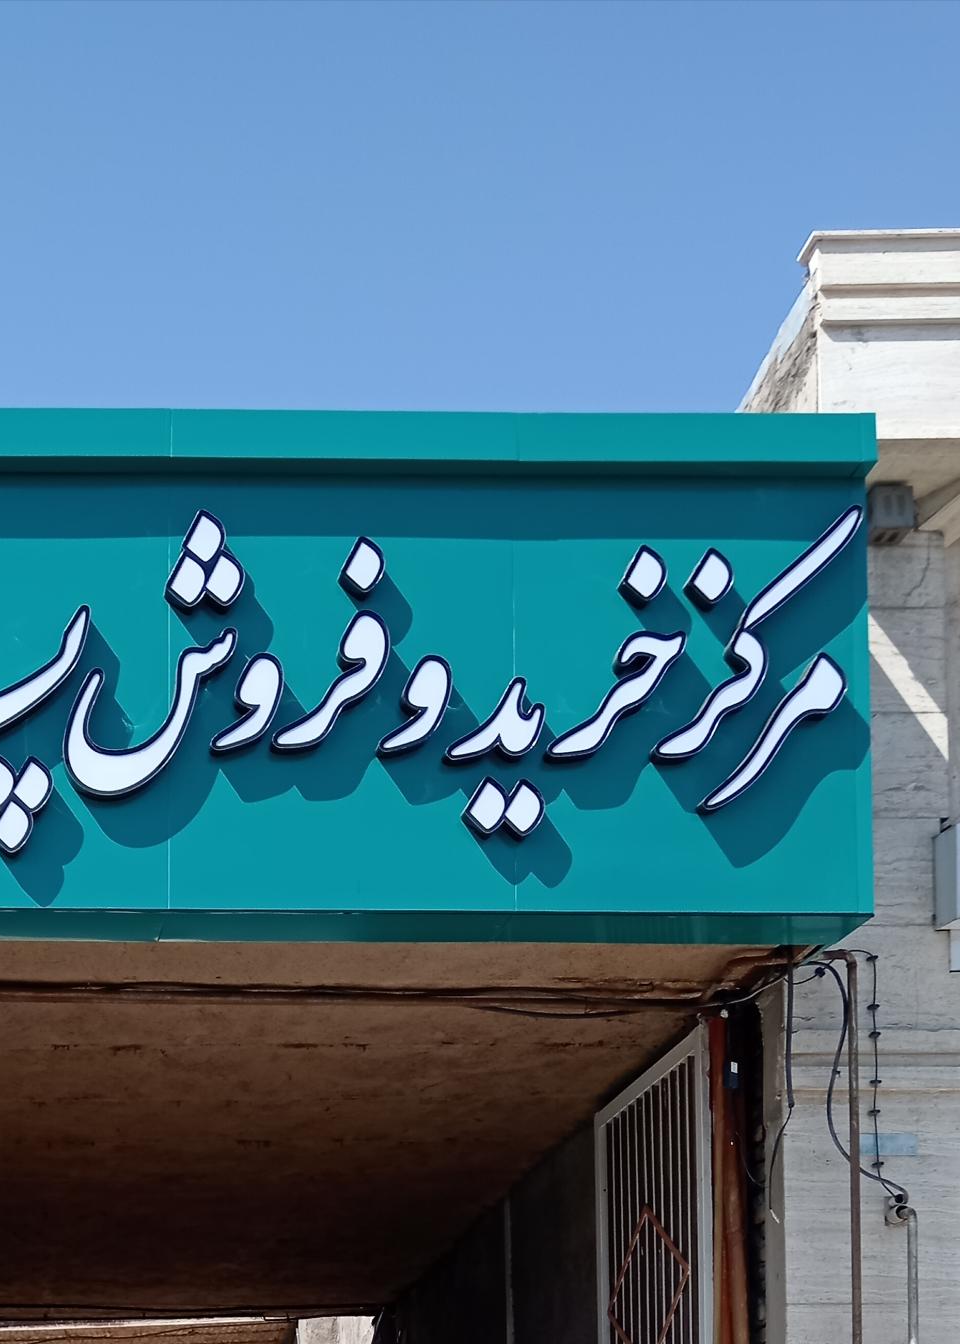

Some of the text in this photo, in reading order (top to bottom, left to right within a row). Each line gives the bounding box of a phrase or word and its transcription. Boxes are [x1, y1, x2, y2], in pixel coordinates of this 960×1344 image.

[64, 510, 391, 800] فروش
[378, 654, 451, 755] و
[446, 546, 686, 838] خرید
[653, 506, 863, 812] مرکز
